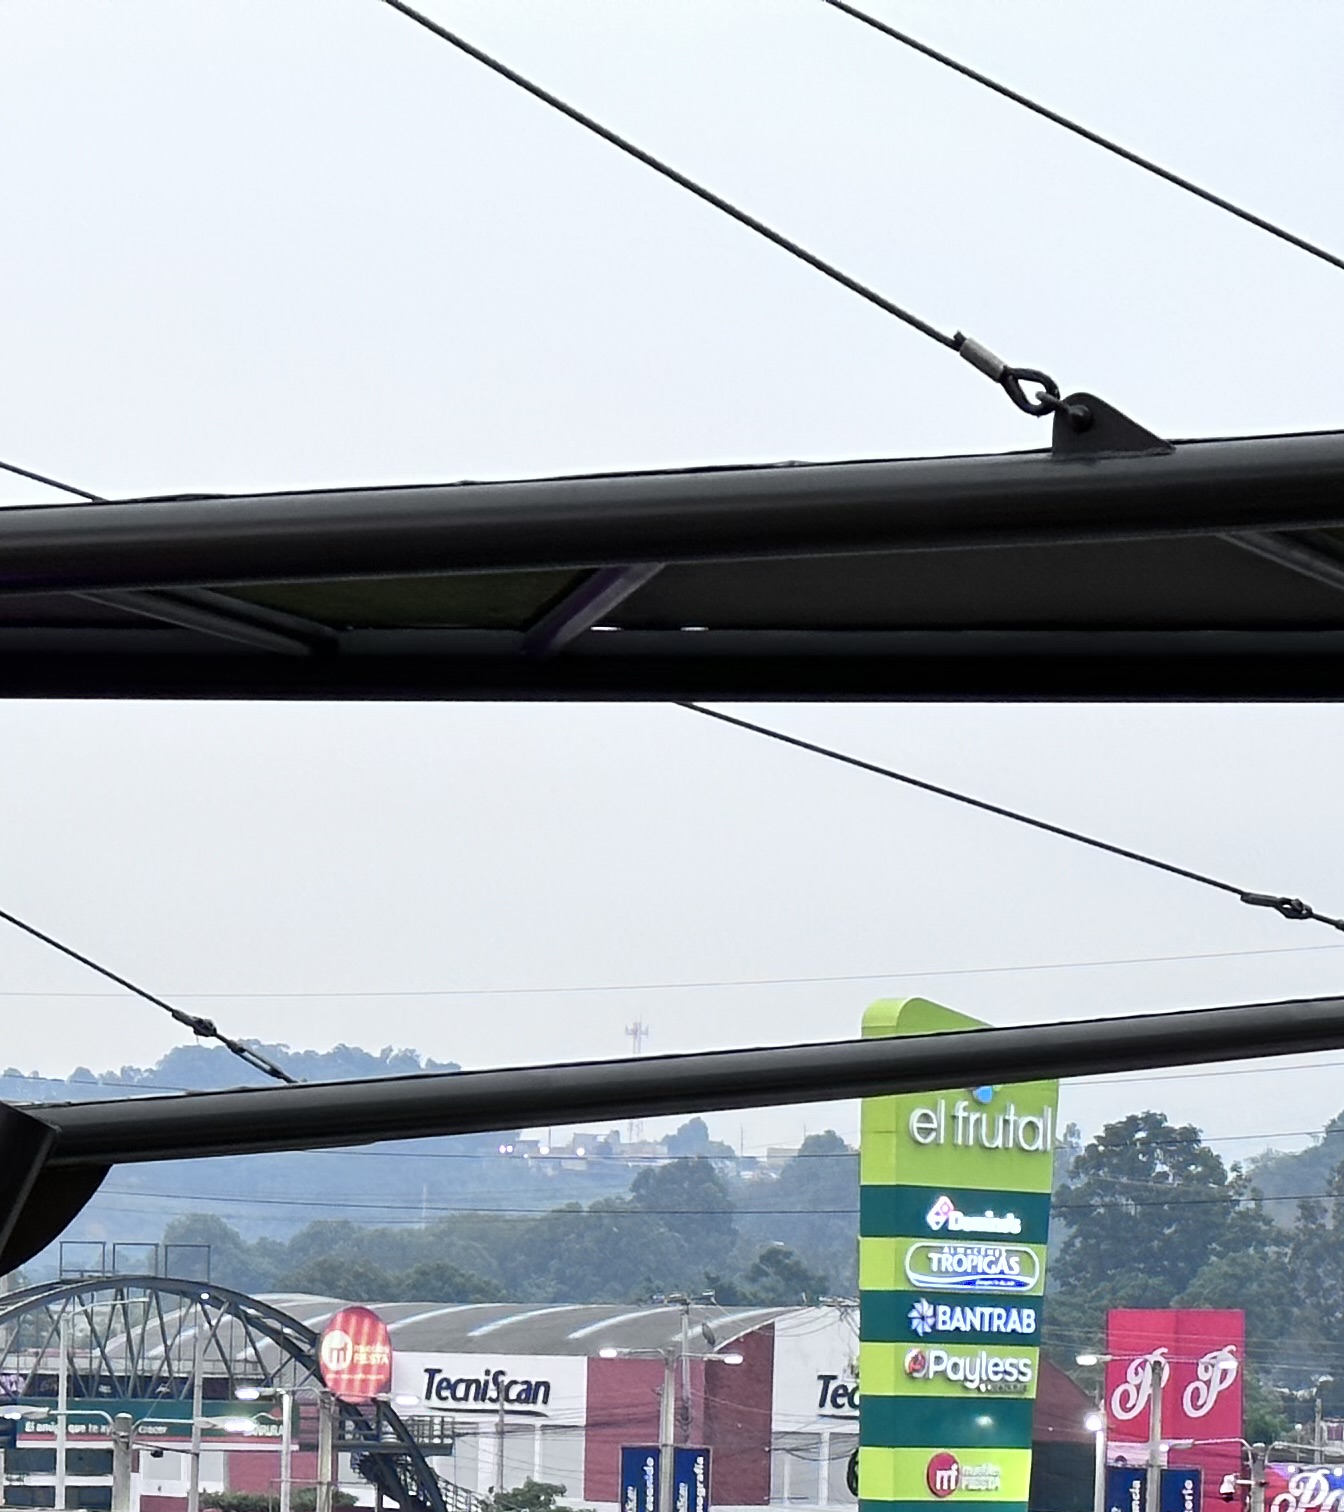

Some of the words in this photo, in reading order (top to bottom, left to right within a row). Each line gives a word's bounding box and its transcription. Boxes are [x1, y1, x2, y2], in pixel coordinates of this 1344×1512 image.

[909, 1099, 946, 1145] el
[952, 1101, 1052, 1153] frutal
[937, 1306, 1036, 1334] BANTRAB
[424, 1367, 551, 1405] TecniScan
[929, 1350, 1033, 1389] Payless
